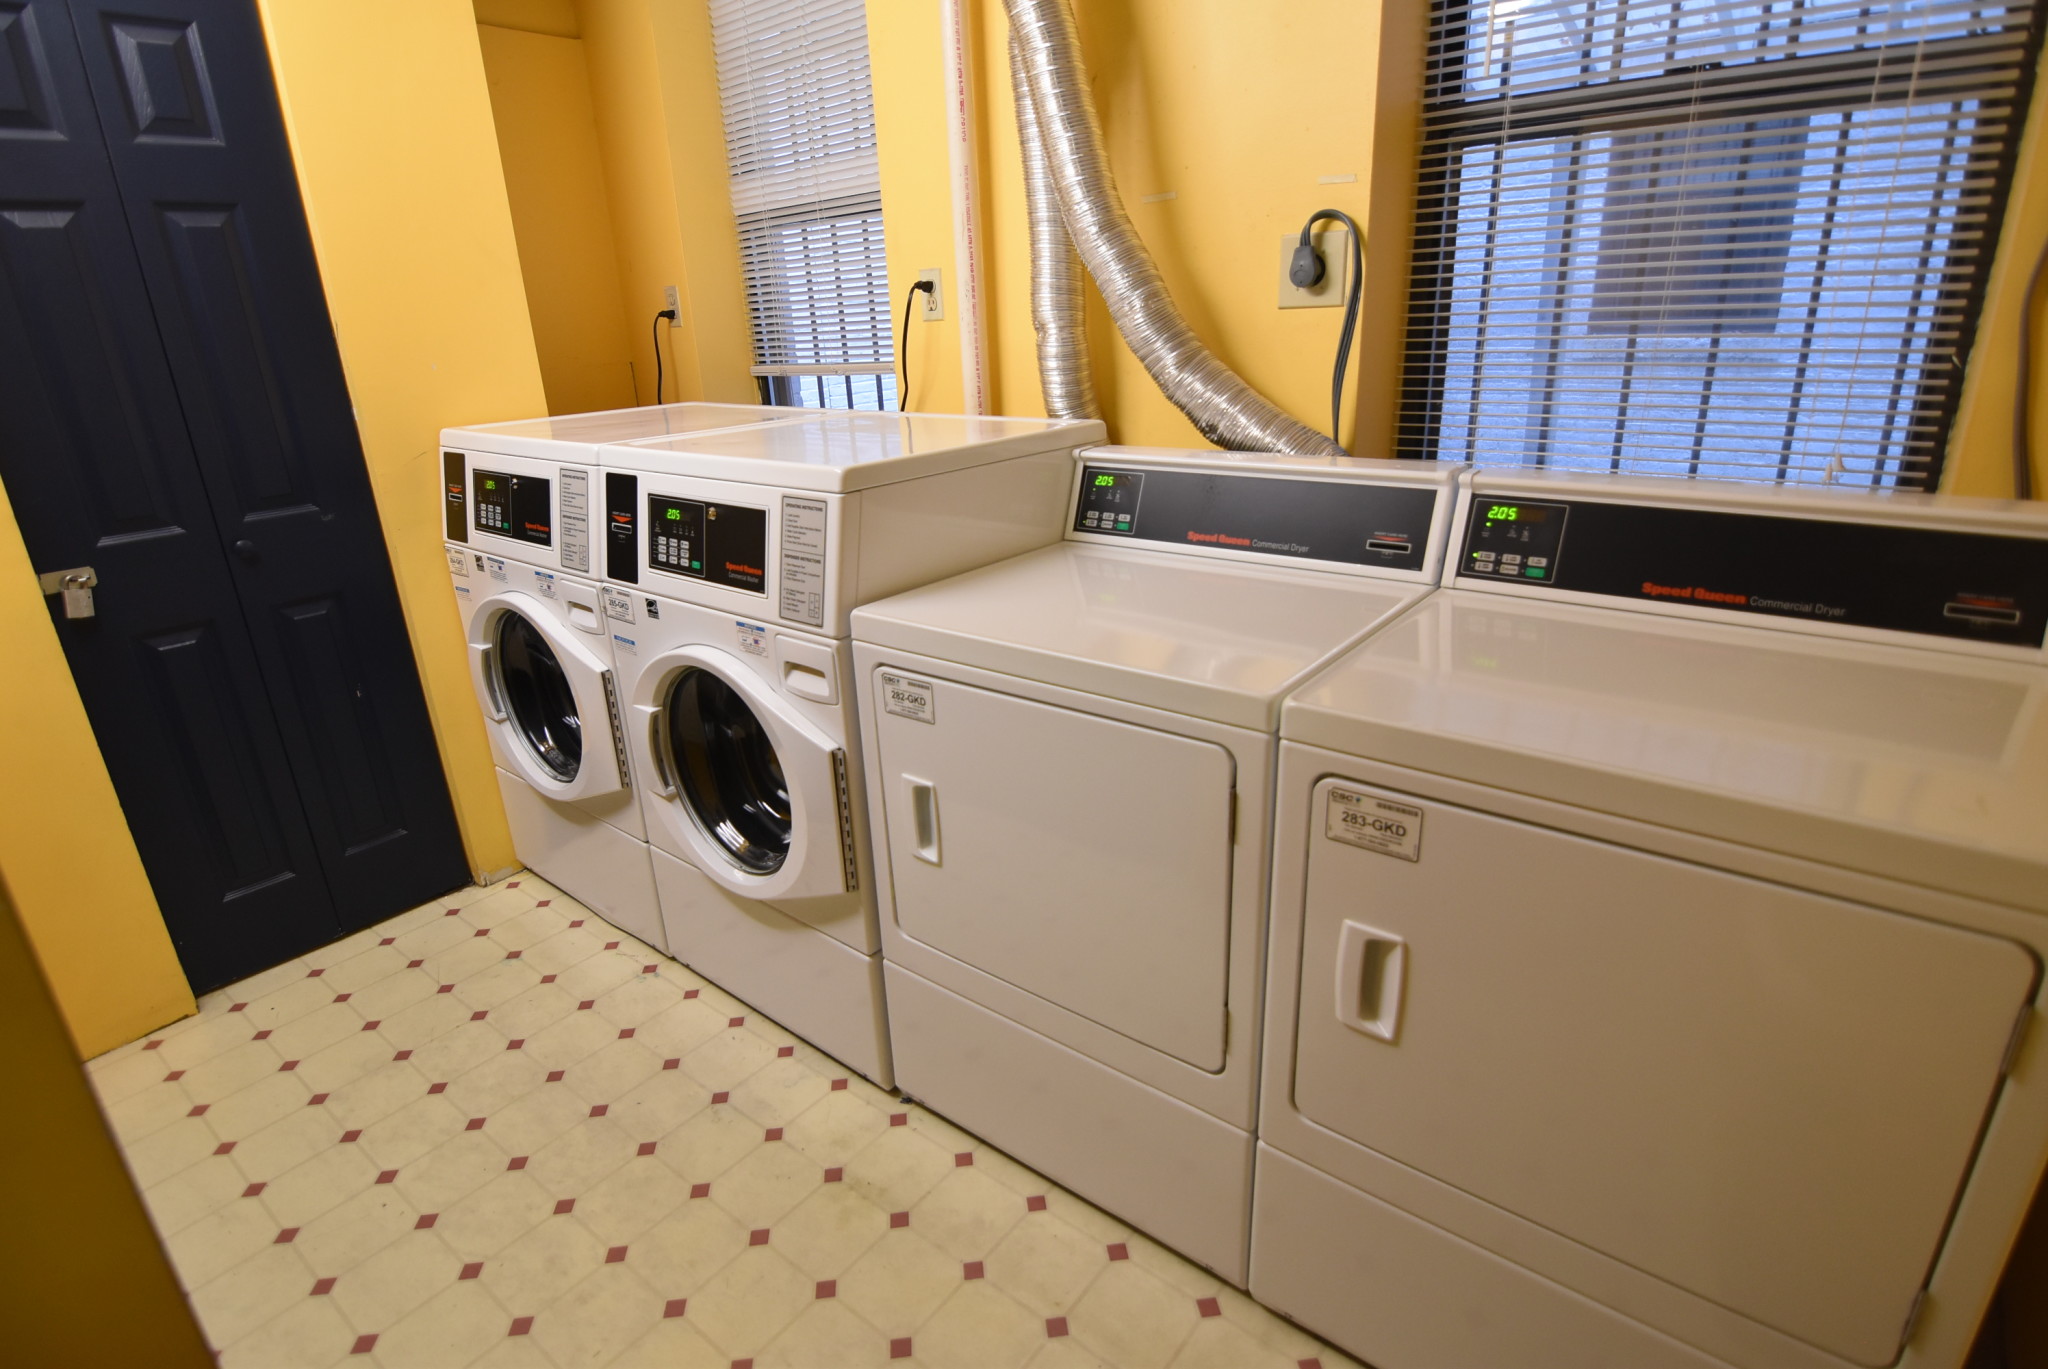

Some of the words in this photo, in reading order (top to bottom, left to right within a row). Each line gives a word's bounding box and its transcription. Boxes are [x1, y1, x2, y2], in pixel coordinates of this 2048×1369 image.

[1187, 531, 1218, 542] Speed
[1218, 534, 1251, 547] Queen
[1252, 539, 1290, 551] Commercial
[1290, 543, 1310, 553] Dryer
[725, 561, 743, 571] Speed
[743, 564, 762, 576] Queen
[1642, 582, 1692, 598] Speed
[1694, 587, 1747, 604] Queen
[1750, 596, 1812, 613] Commercial
[1815, 603, 1846, 617] Dryer
[891, 689, 926, 706] 282-GKD
[1341, 810, 1407, 837] 283-GKD
